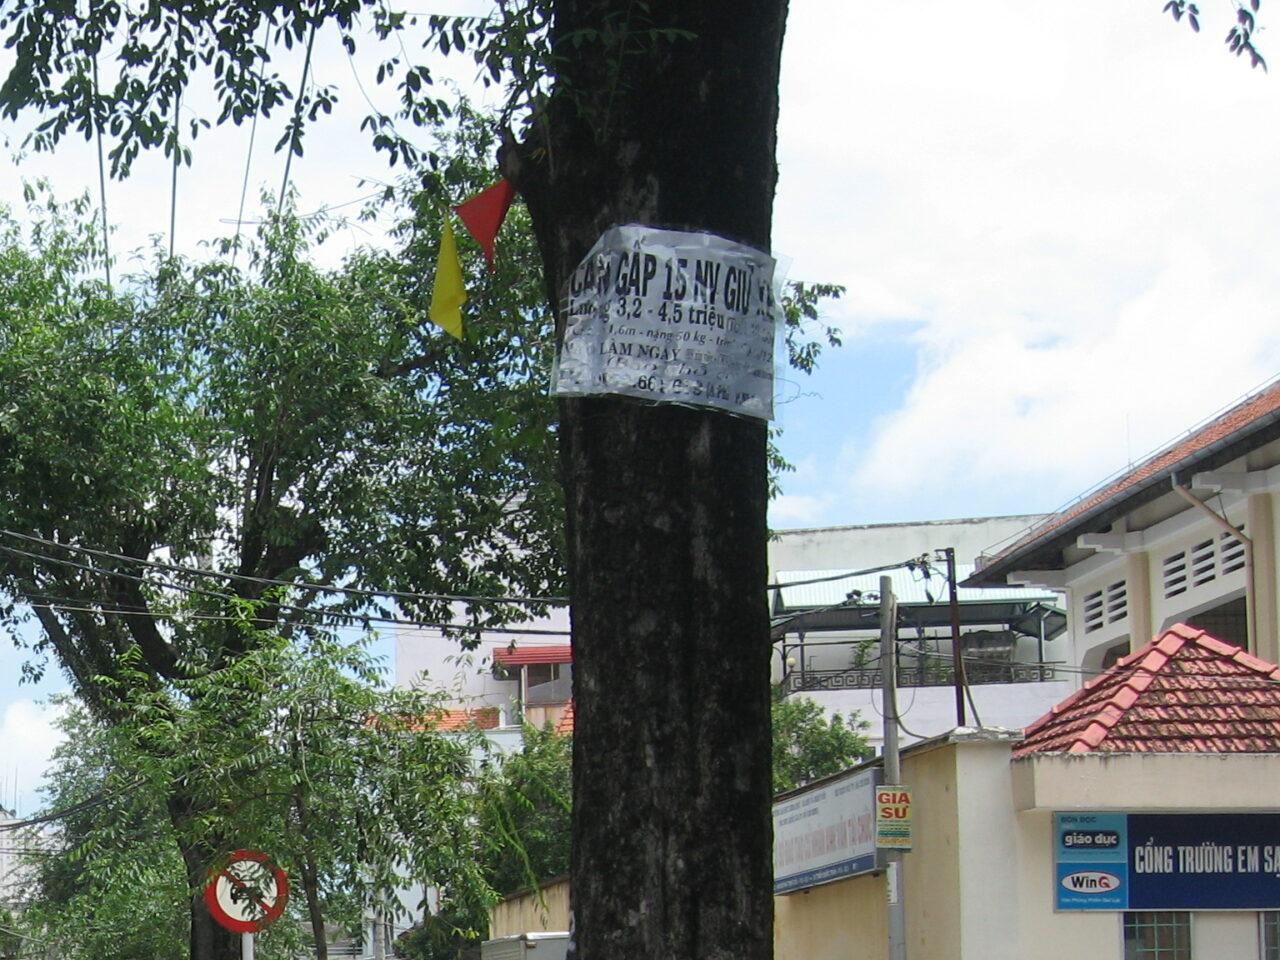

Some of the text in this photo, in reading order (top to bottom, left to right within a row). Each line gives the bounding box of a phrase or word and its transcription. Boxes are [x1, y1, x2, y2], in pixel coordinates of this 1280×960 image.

[663, 258, 688, 301] 15
[617, 297, 642, 320] 3,2
[658, 302, 683, 325] 4,5
[689, 305, 725, 331] triệu
[878, 792, 911, 805] GIA
[881, 805, 909, 819] SƯ
[1065, 832, 1092, 846] giáo
[1135, 837, 1173, 874] CỔNG
[1177, 842, 1233, 874] TRƯỜNG
[1237, 846, 1260, 873] EM
